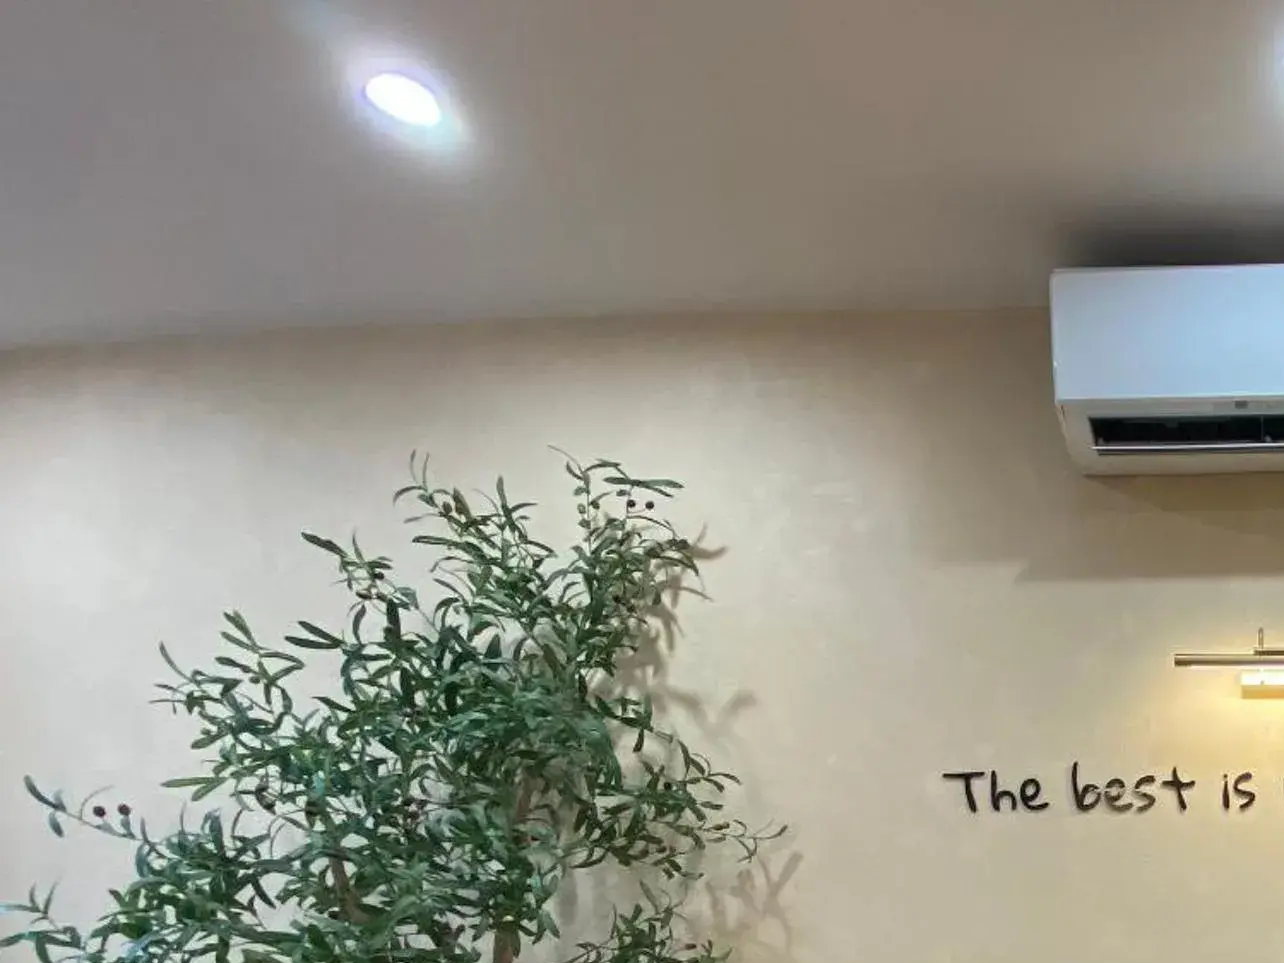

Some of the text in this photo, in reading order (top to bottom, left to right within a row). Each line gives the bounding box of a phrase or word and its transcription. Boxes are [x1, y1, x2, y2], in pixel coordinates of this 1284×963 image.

[941, 771, 1050, 814] The
[1071, 761, 1196, 814] best
[1221, 771, 1256, 813] is
